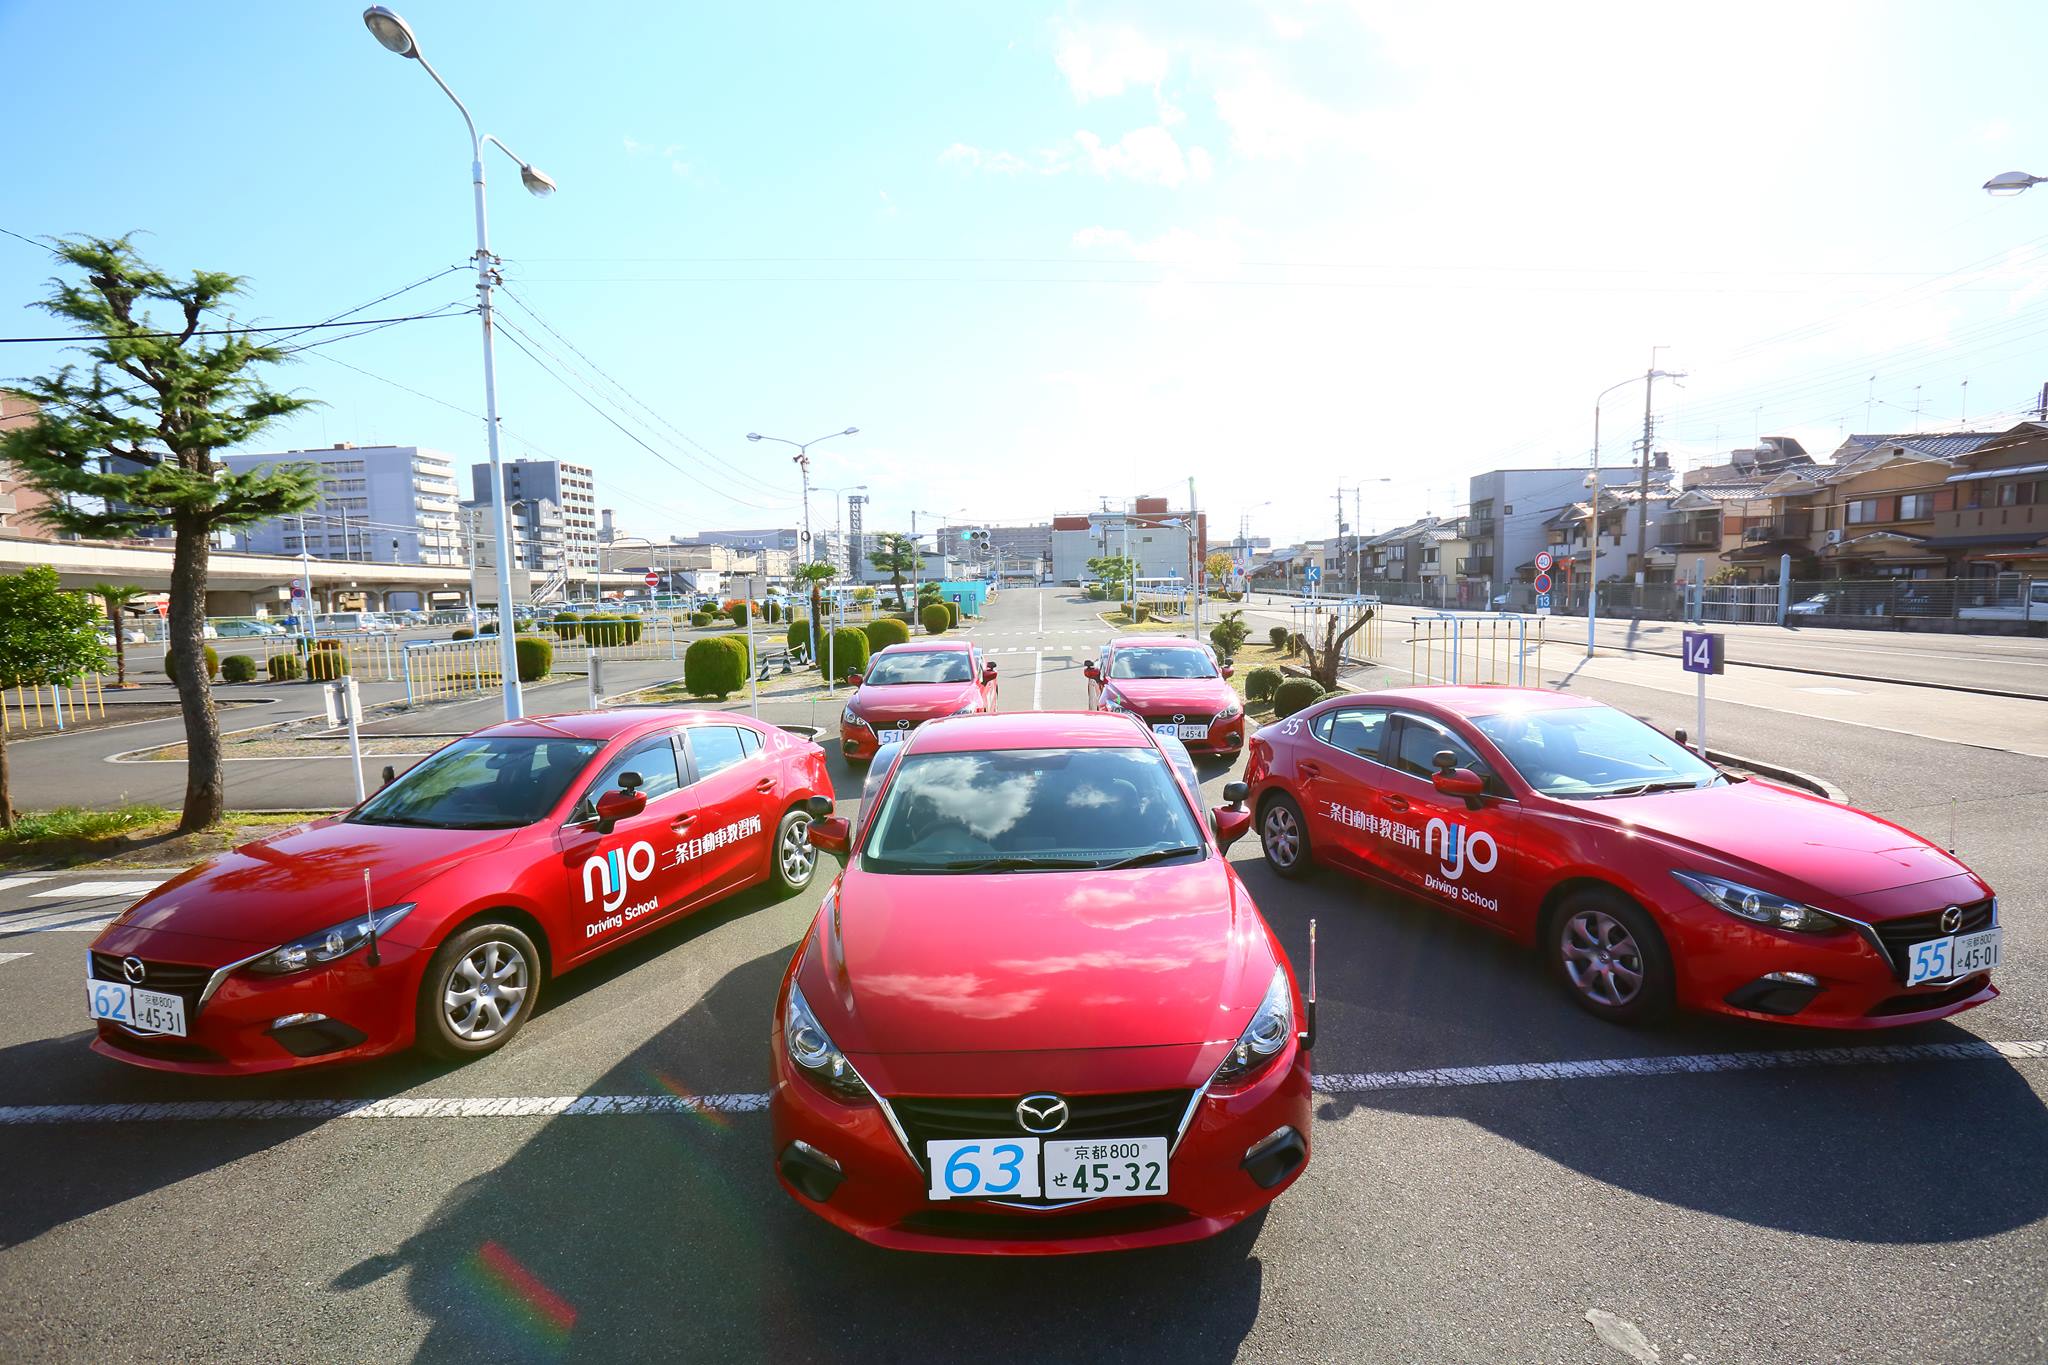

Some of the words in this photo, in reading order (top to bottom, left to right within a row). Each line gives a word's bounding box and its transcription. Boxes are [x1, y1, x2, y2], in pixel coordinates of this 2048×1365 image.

[1308, 568, 1318, 580] K
[954, 594, 960, 602] 4
[1539, 596, 1550, 607] 13
[1685, 636, 1710, 669] 14
[882, 731, 900, 743] 51
[1156, 725, 1175, 736] 69
[1281, 718, 1303, 735] 55
[773, 733, 793, 750] 62
[1318, 800, 1420, 849] 二条自動車教習所
[662, 815, 761, 870] 二条自動車教習所
[1425, 874, 1458, 899] Driving
[1462, 888, 1498, 912] School
[586, 914, 623, 938] Driving
[625, 896, 659, 921] School
[1914, 941, 1948, 980] 55
[1965, 945, 1998, 969] 45-01
[95, 984, 127, 1020] 62
[146, 1008, 181, 1033] 45-31
[944, 1144, 1025, 1194] 63
[1052, 1173, 1068, 1187] せ
[1072, 1161, 1161, 1193] 45-32
